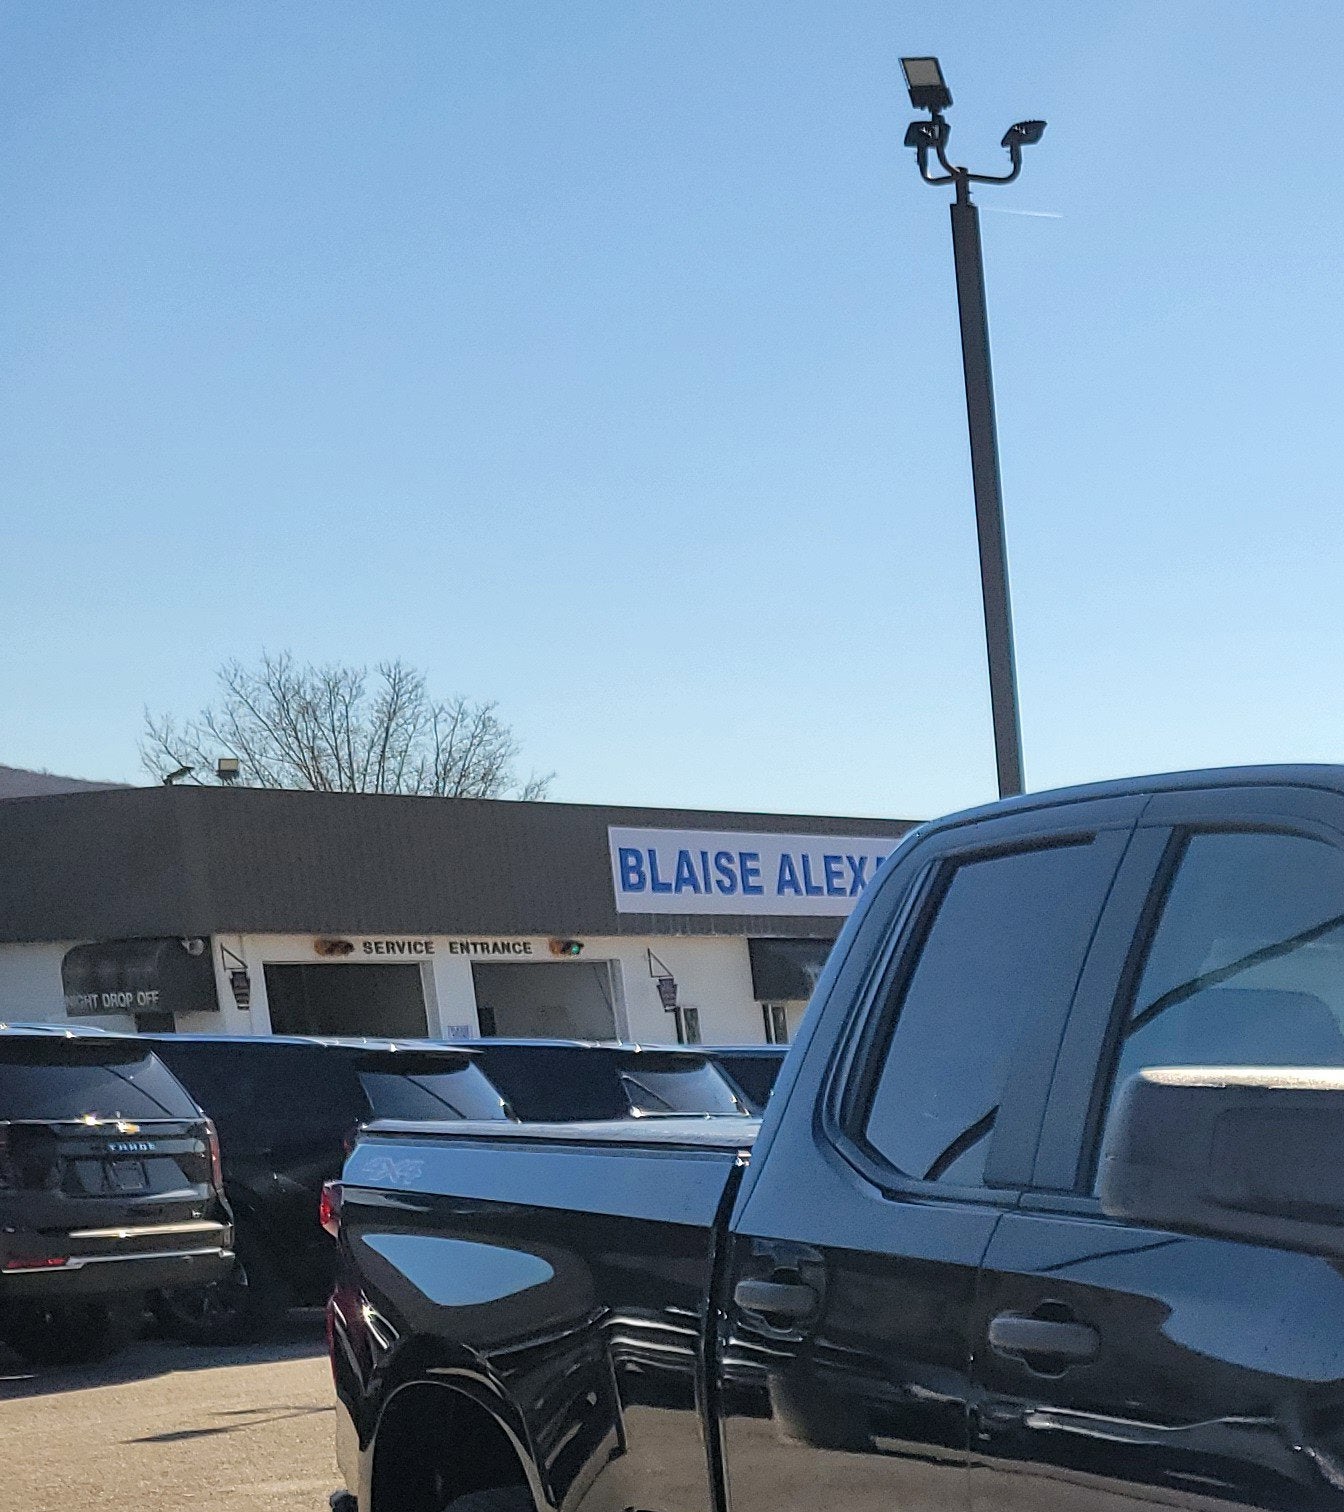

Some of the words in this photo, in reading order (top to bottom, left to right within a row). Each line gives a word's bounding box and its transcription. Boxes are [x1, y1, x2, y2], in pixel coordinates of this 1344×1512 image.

[618, 846, 765, 896] BLAISE
[776, 852, 887, 898] ALEX
[362, 940, 436, 955] SERVICE
[448, 940, 533, 955] ENTRANCE
[102, 992, 134, 1009] DROP
[137, 989, 160, 1007] OFF
